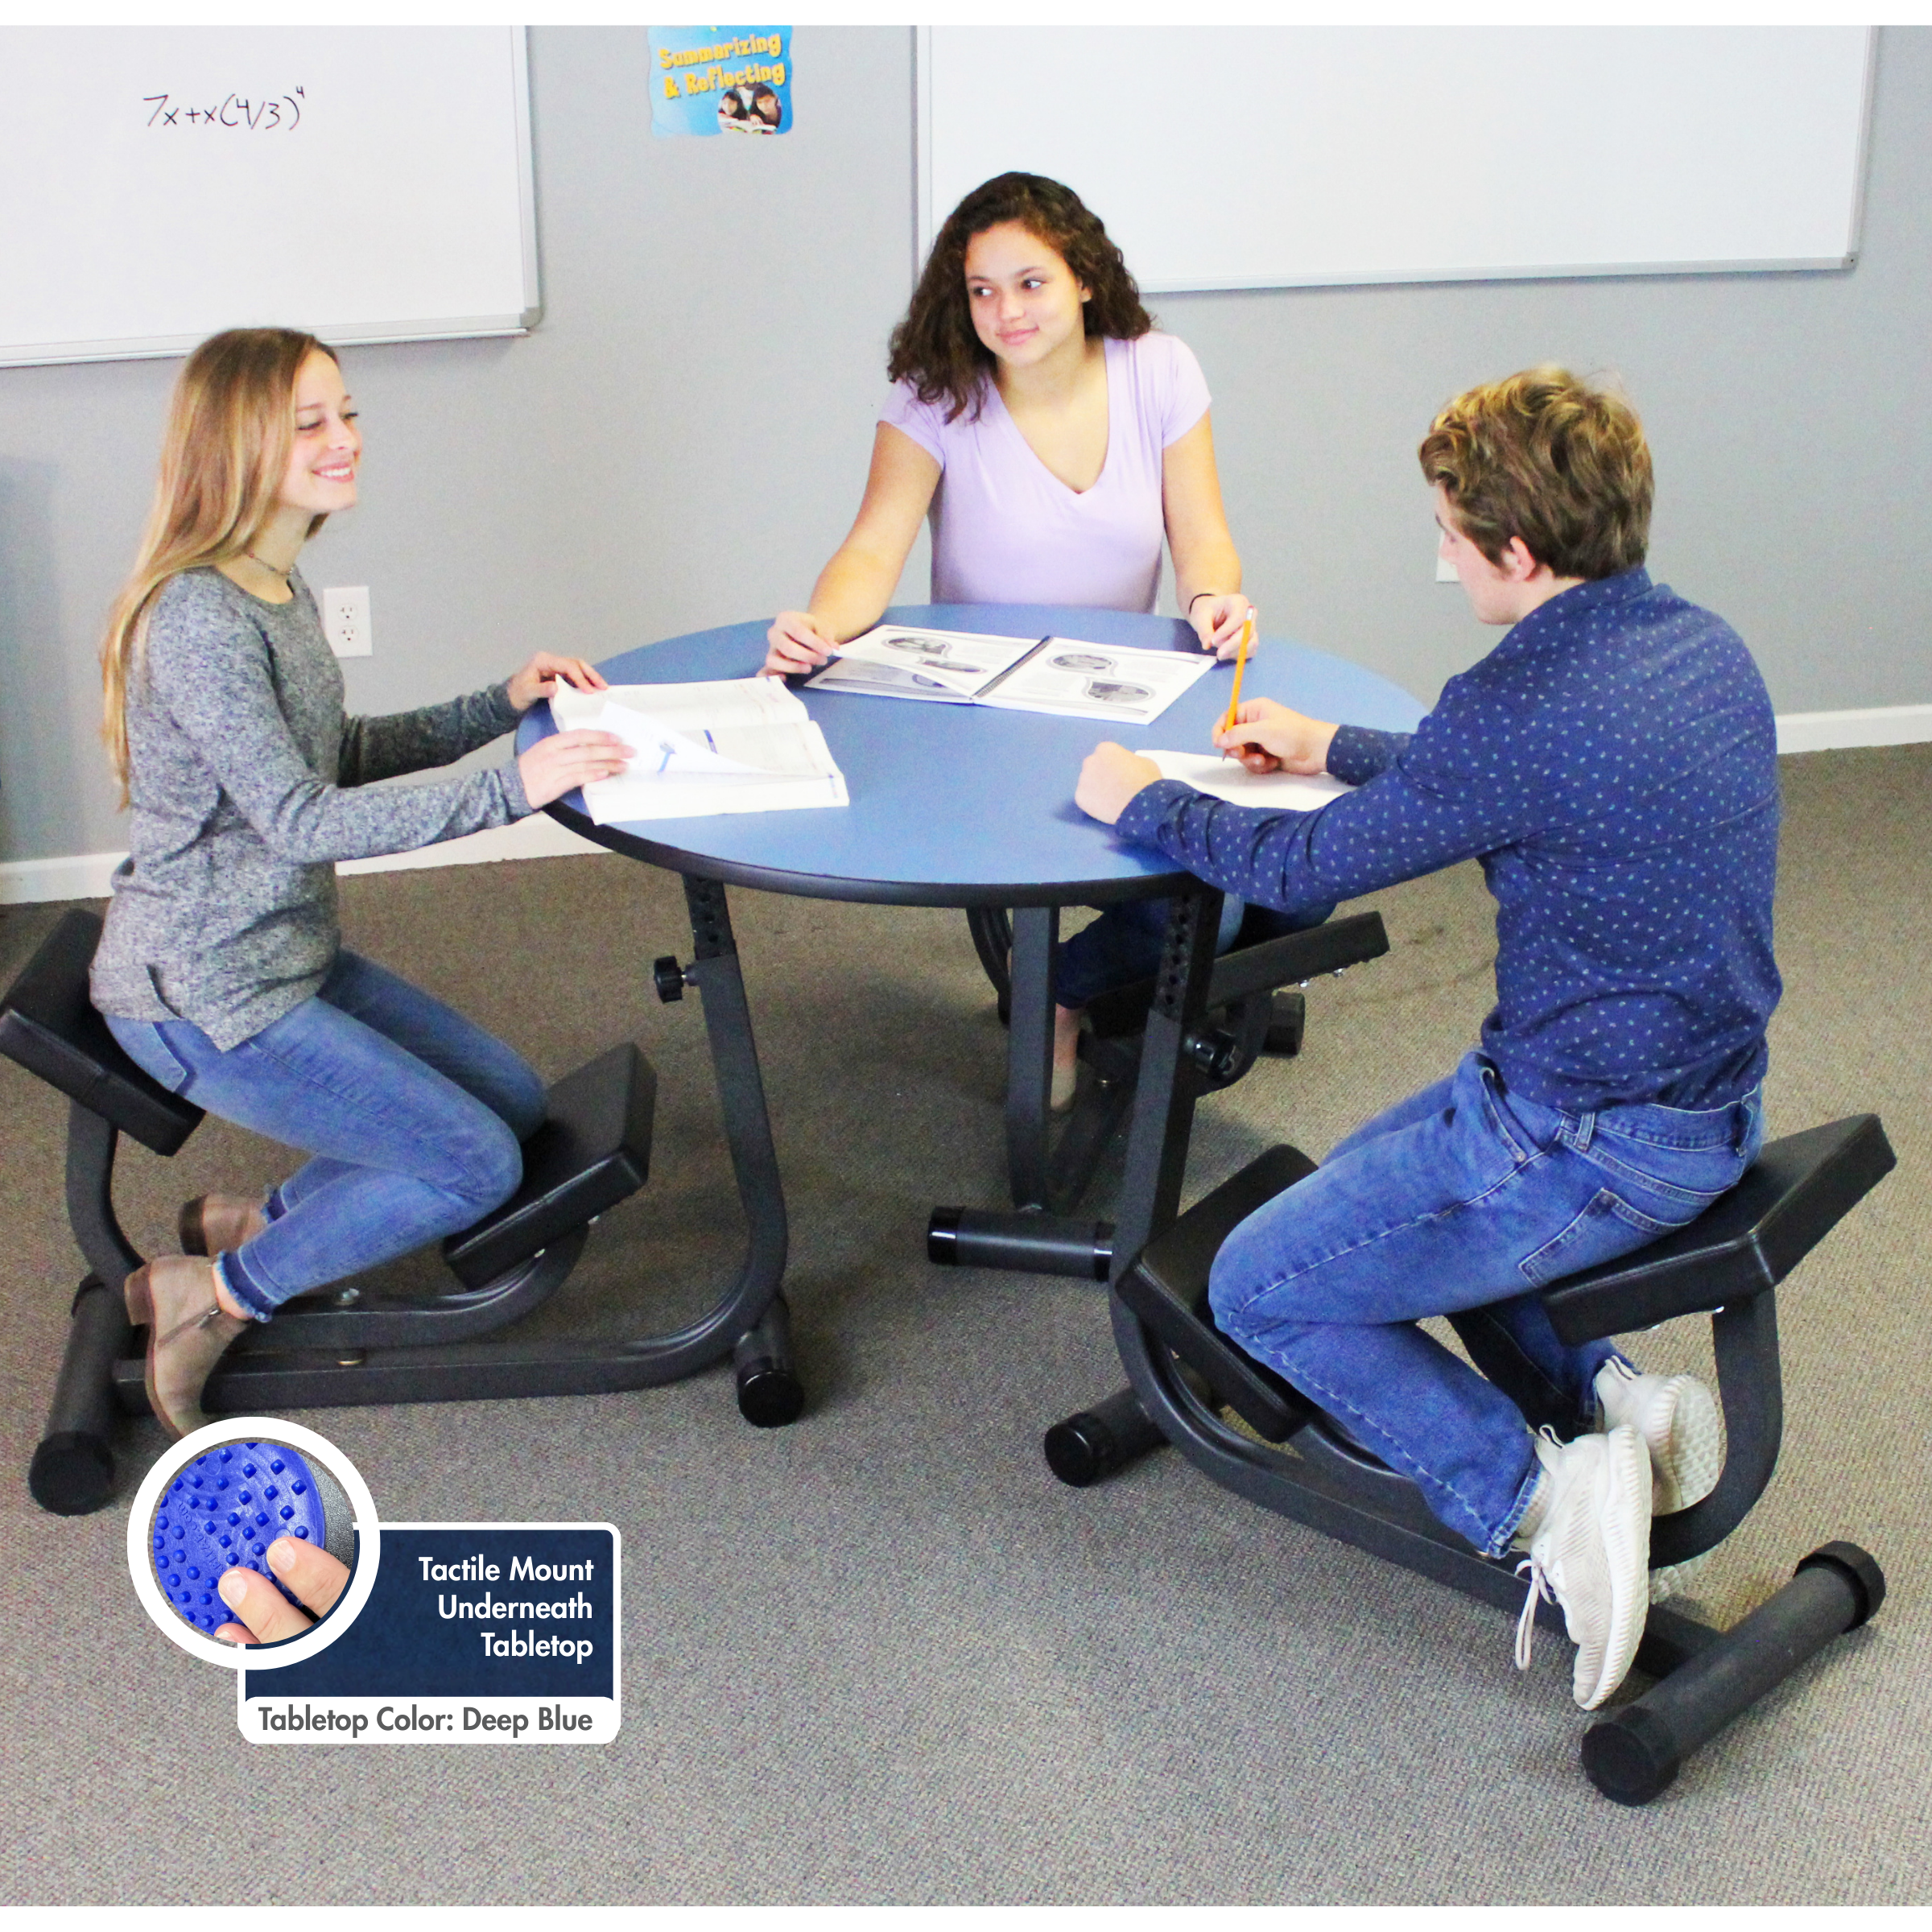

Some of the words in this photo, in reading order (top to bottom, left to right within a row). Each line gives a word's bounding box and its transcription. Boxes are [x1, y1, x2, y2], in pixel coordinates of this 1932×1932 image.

[658, 33, 782, 69] Summarizing
[663, 75, 680, 99] &
[684, 63, 786, 96] Reflecting
